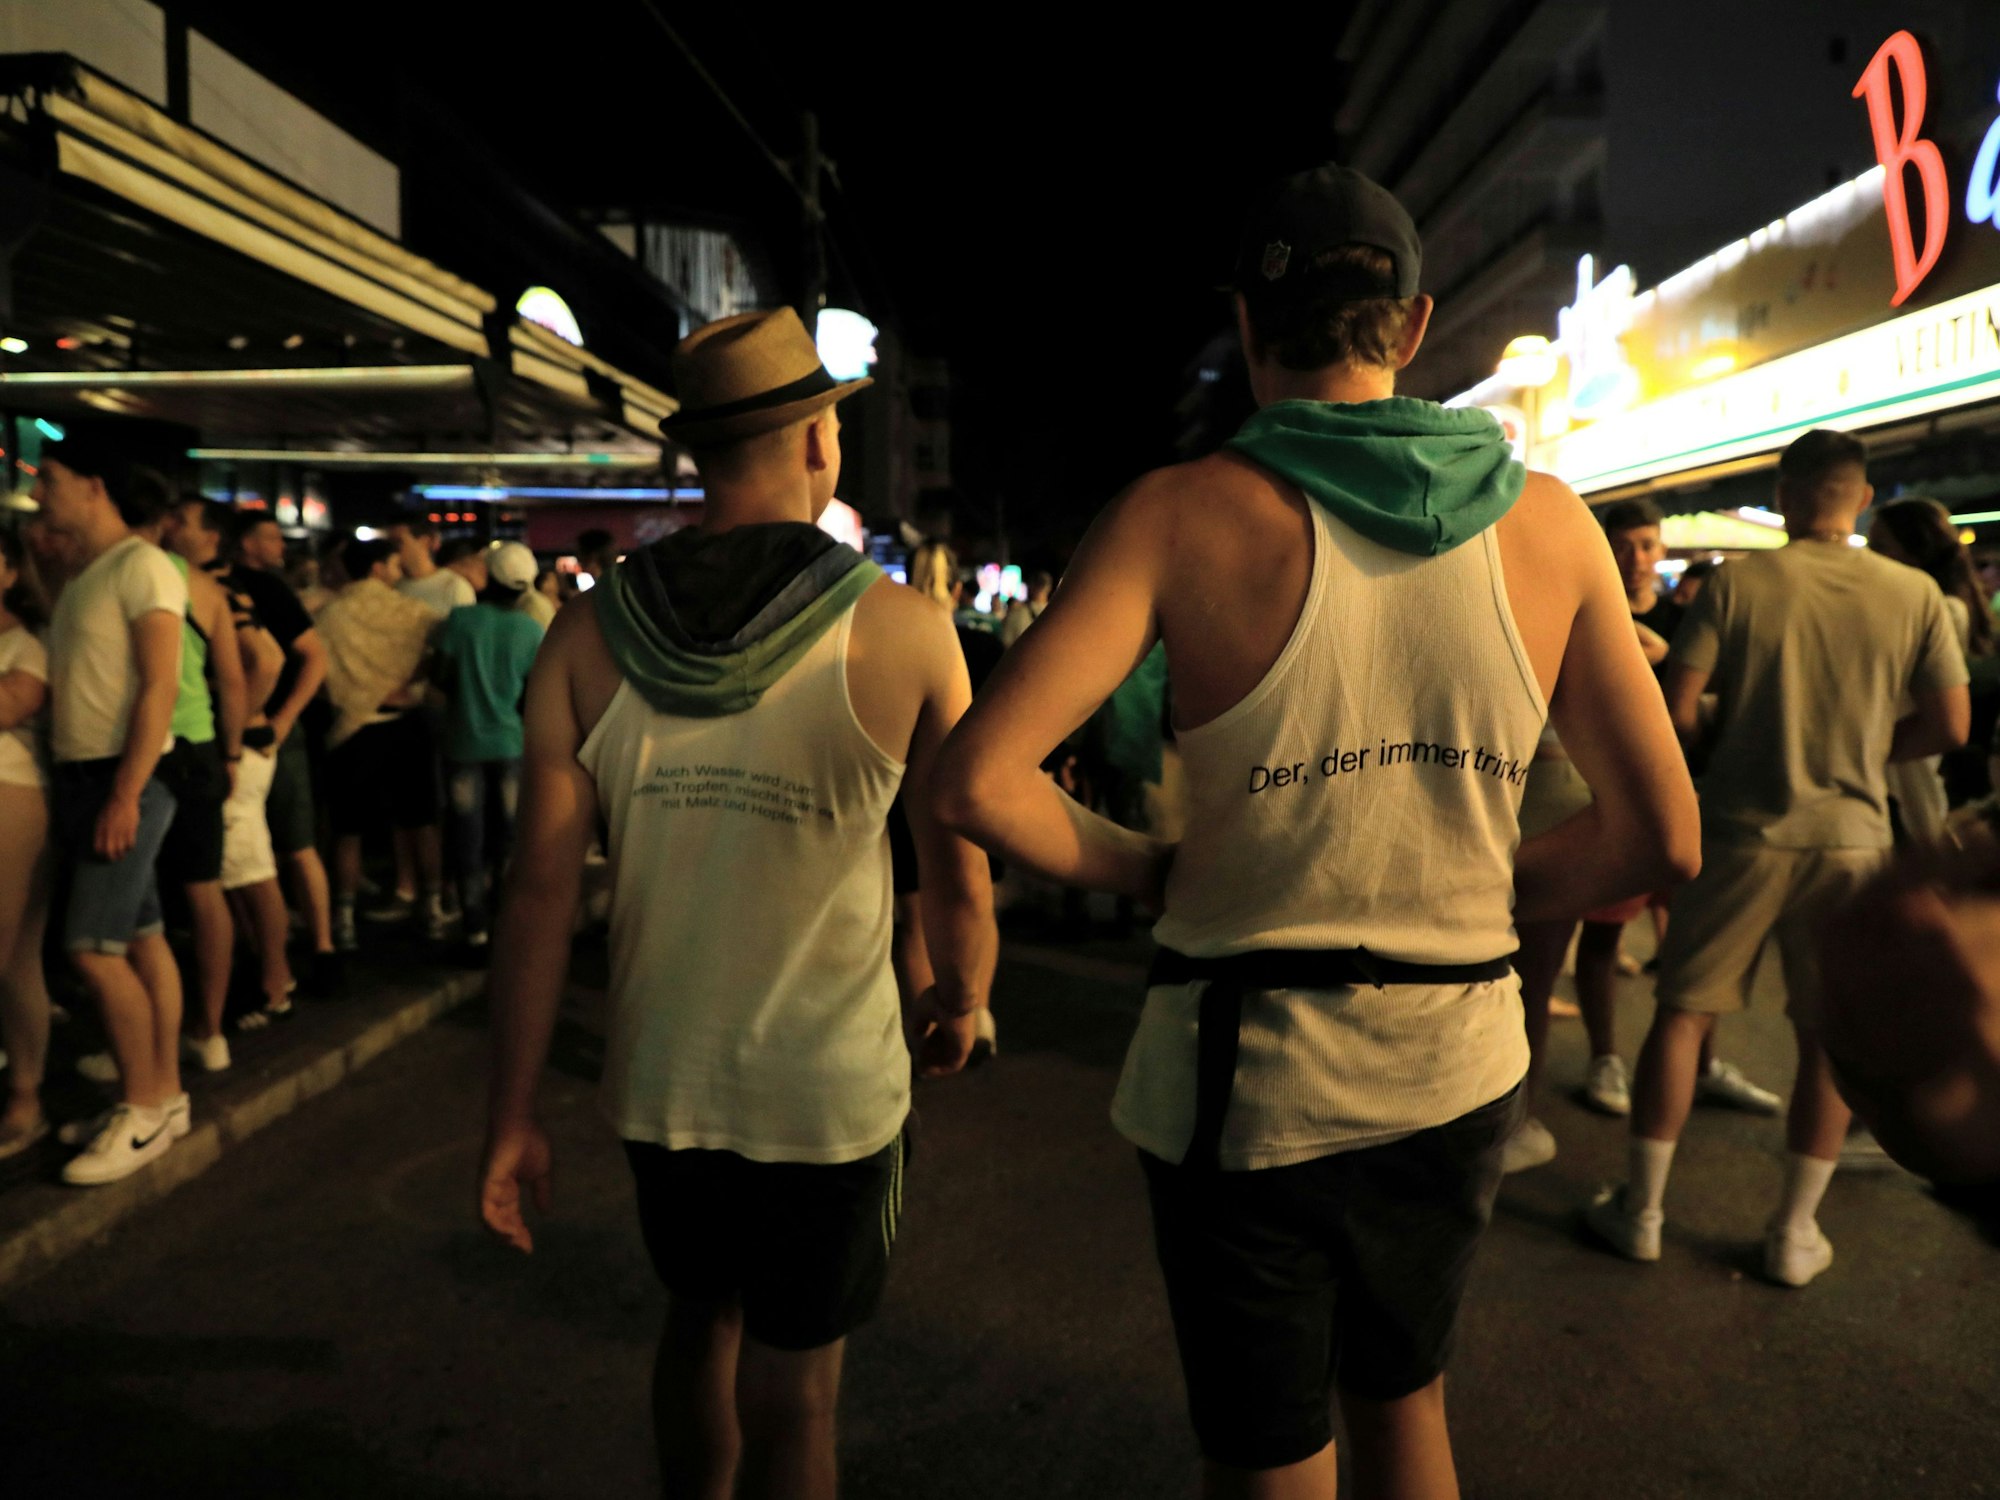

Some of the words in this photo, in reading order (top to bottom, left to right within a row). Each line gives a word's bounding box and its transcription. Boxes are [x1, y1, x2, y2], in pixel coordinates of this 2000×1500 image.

[655, 766, 690, 778] Auch
[694, 764, 746, 779] Wasser
[751, 772, 781, 788] wird
[1249, 761, 1309, 795] Der,
[1320, 748, 1370, 777] der
[1379, 738, 1470, 770] immer
[684, 795, 721, 809] Malz
[724, 799, 747, 813] und
[735, 786, 780, 804] mischt
